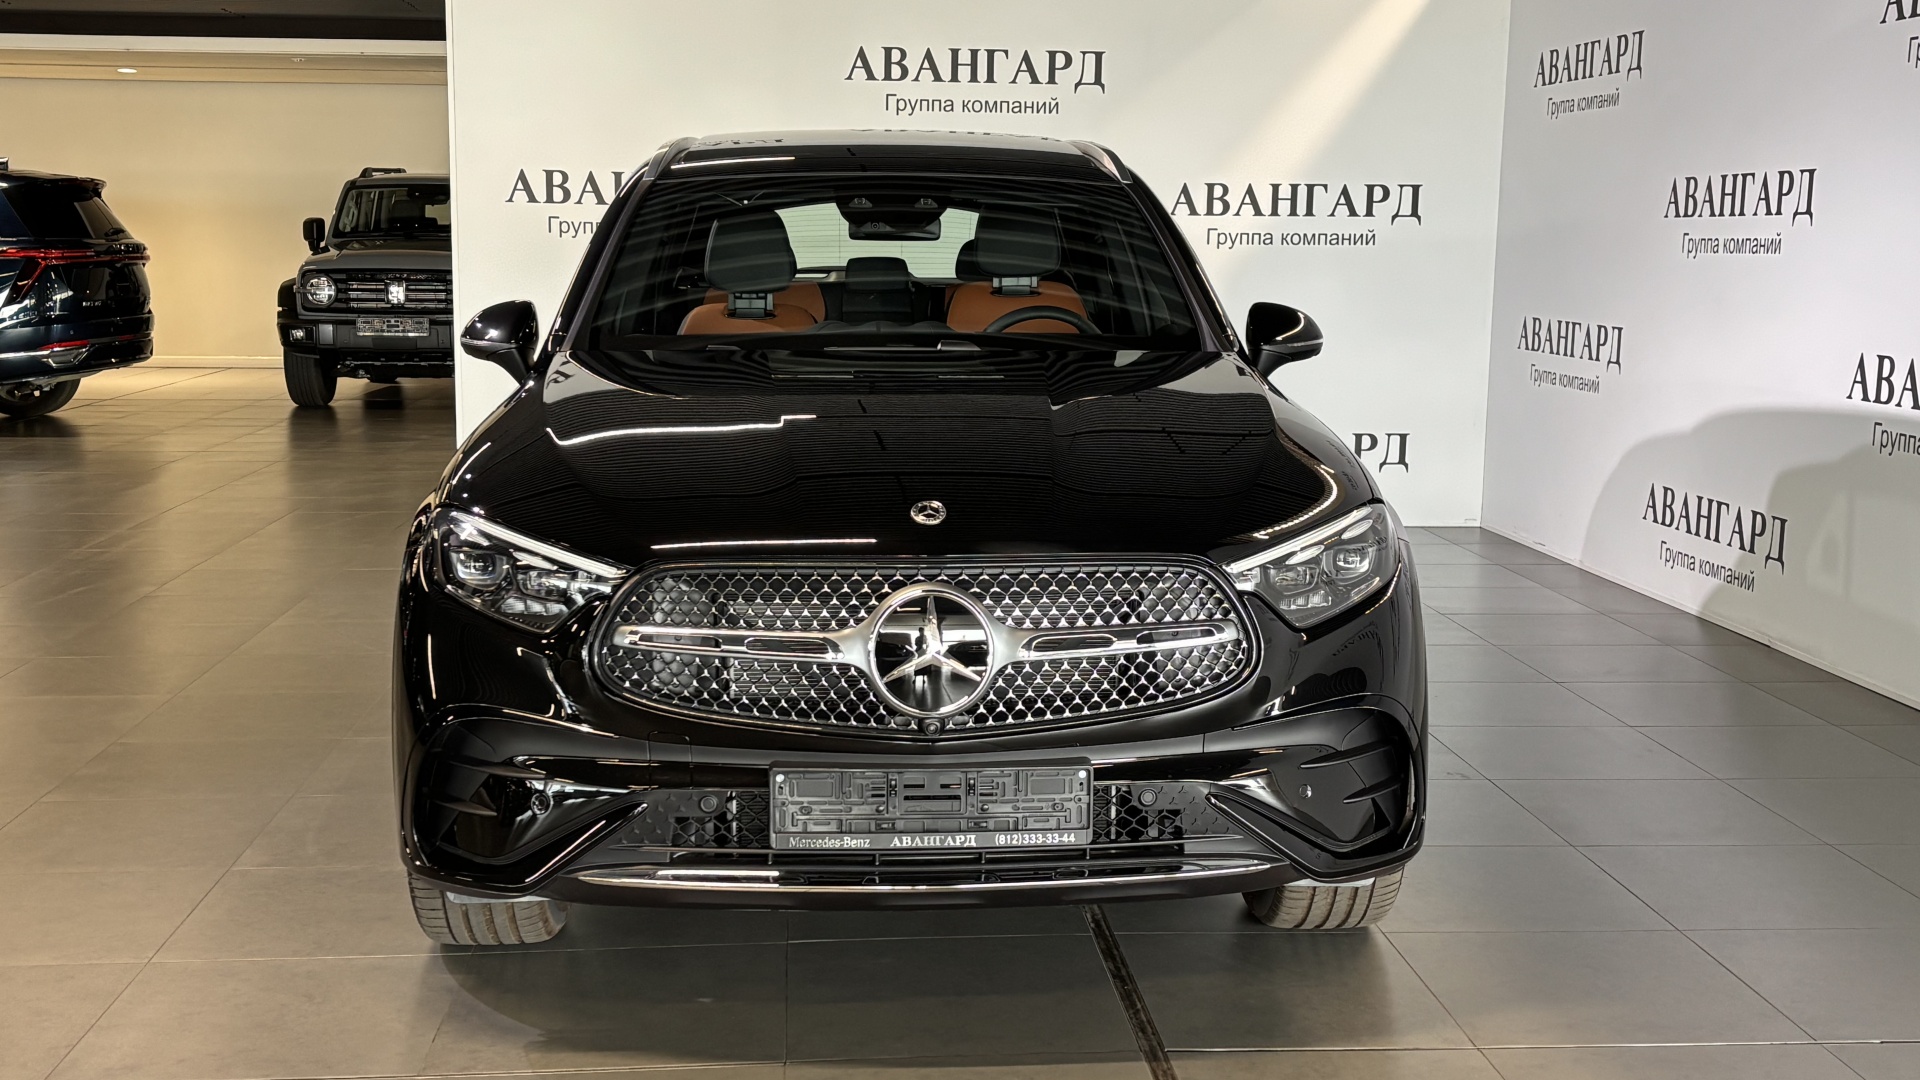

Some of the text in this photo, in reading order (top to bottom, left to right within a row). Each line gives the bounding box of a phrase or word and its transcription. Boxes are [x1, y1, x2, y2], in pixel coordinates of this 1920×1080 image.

[844, 45, 1107, 95] АВАНГАРД
[1533, 29, 1645, 88] АВАНГАРД
[884, 94, 1060, 117] Группа компаний
[1546, 87, 1620, 120] Группа компаний
[1171, 182, 1424, 226] АВАНГАРД
[1663, 168, 1818, 227] АВАНГАРД
[1205, 227, 1377, 250] Группа компаний
[1681, 231, 1782, 260] Группа компаний
[1517, 315, 1624, 375] АВАНГАРД
[1529, 363, 1601, 395] Группа компаний
[1642, 482, 1789, 575] АВАНГАРД
[1659, 540, 1757, 594] Группа компаний
[788, 836, 871, 848] Mercedes-Benz
[889, 834, 977, 848] АВАНГАРД
[994, 832, 1076, 846] (812)333-33-44
